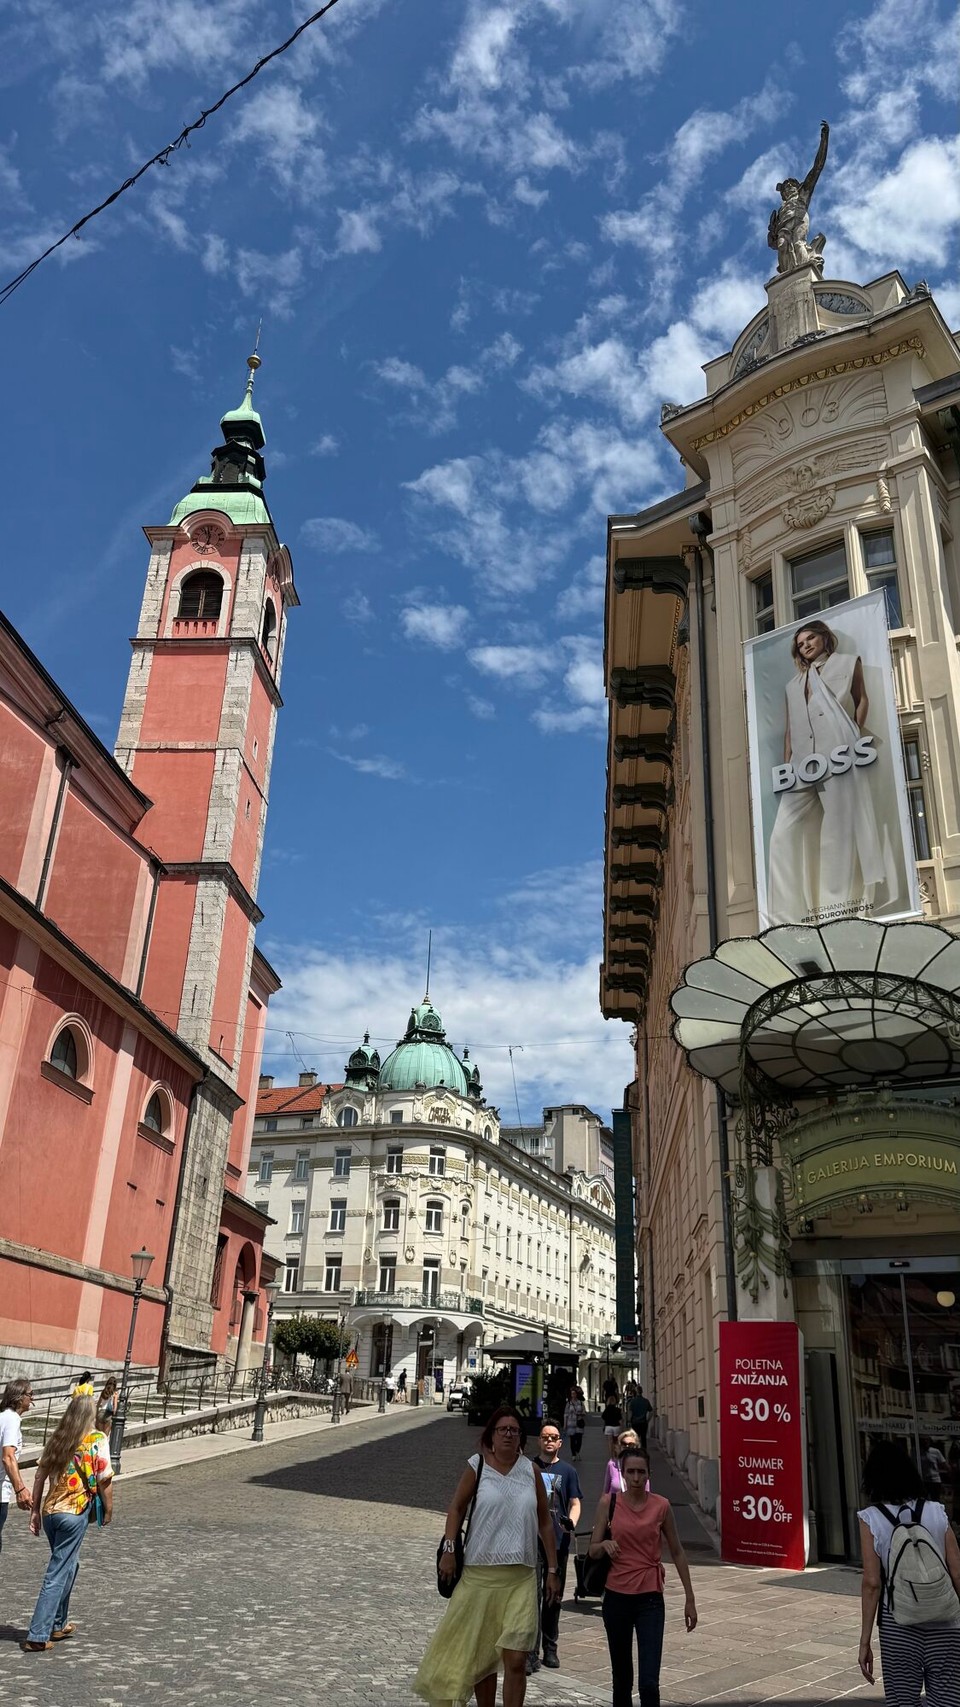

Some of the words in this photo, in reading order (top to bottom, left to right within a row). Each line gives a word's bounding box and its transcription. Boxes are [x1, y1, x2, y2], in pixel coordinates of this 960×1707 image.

[764, 400, 840, 451] 1903
[771, 735, 878, 794] BOSS
[807, 901, 846, 915] MEGHANN
[846, 897, 866, 907] FAHY
[617, 1123, 632, 1225] EMPORIUM
[807, 1156, 870, 1184] GALERIJA
[874, 1153, 958, 1175] EMPORIUM
[735, 1358, 783, 1370] POLETNA
[731, 1371, 788, 1386] ZNIŽANJA
[738, 1456, 784, 1470] SUMMER
[747, 1473, 775, 1486] SALE
[773, 1513, 793, 1523] OFF
